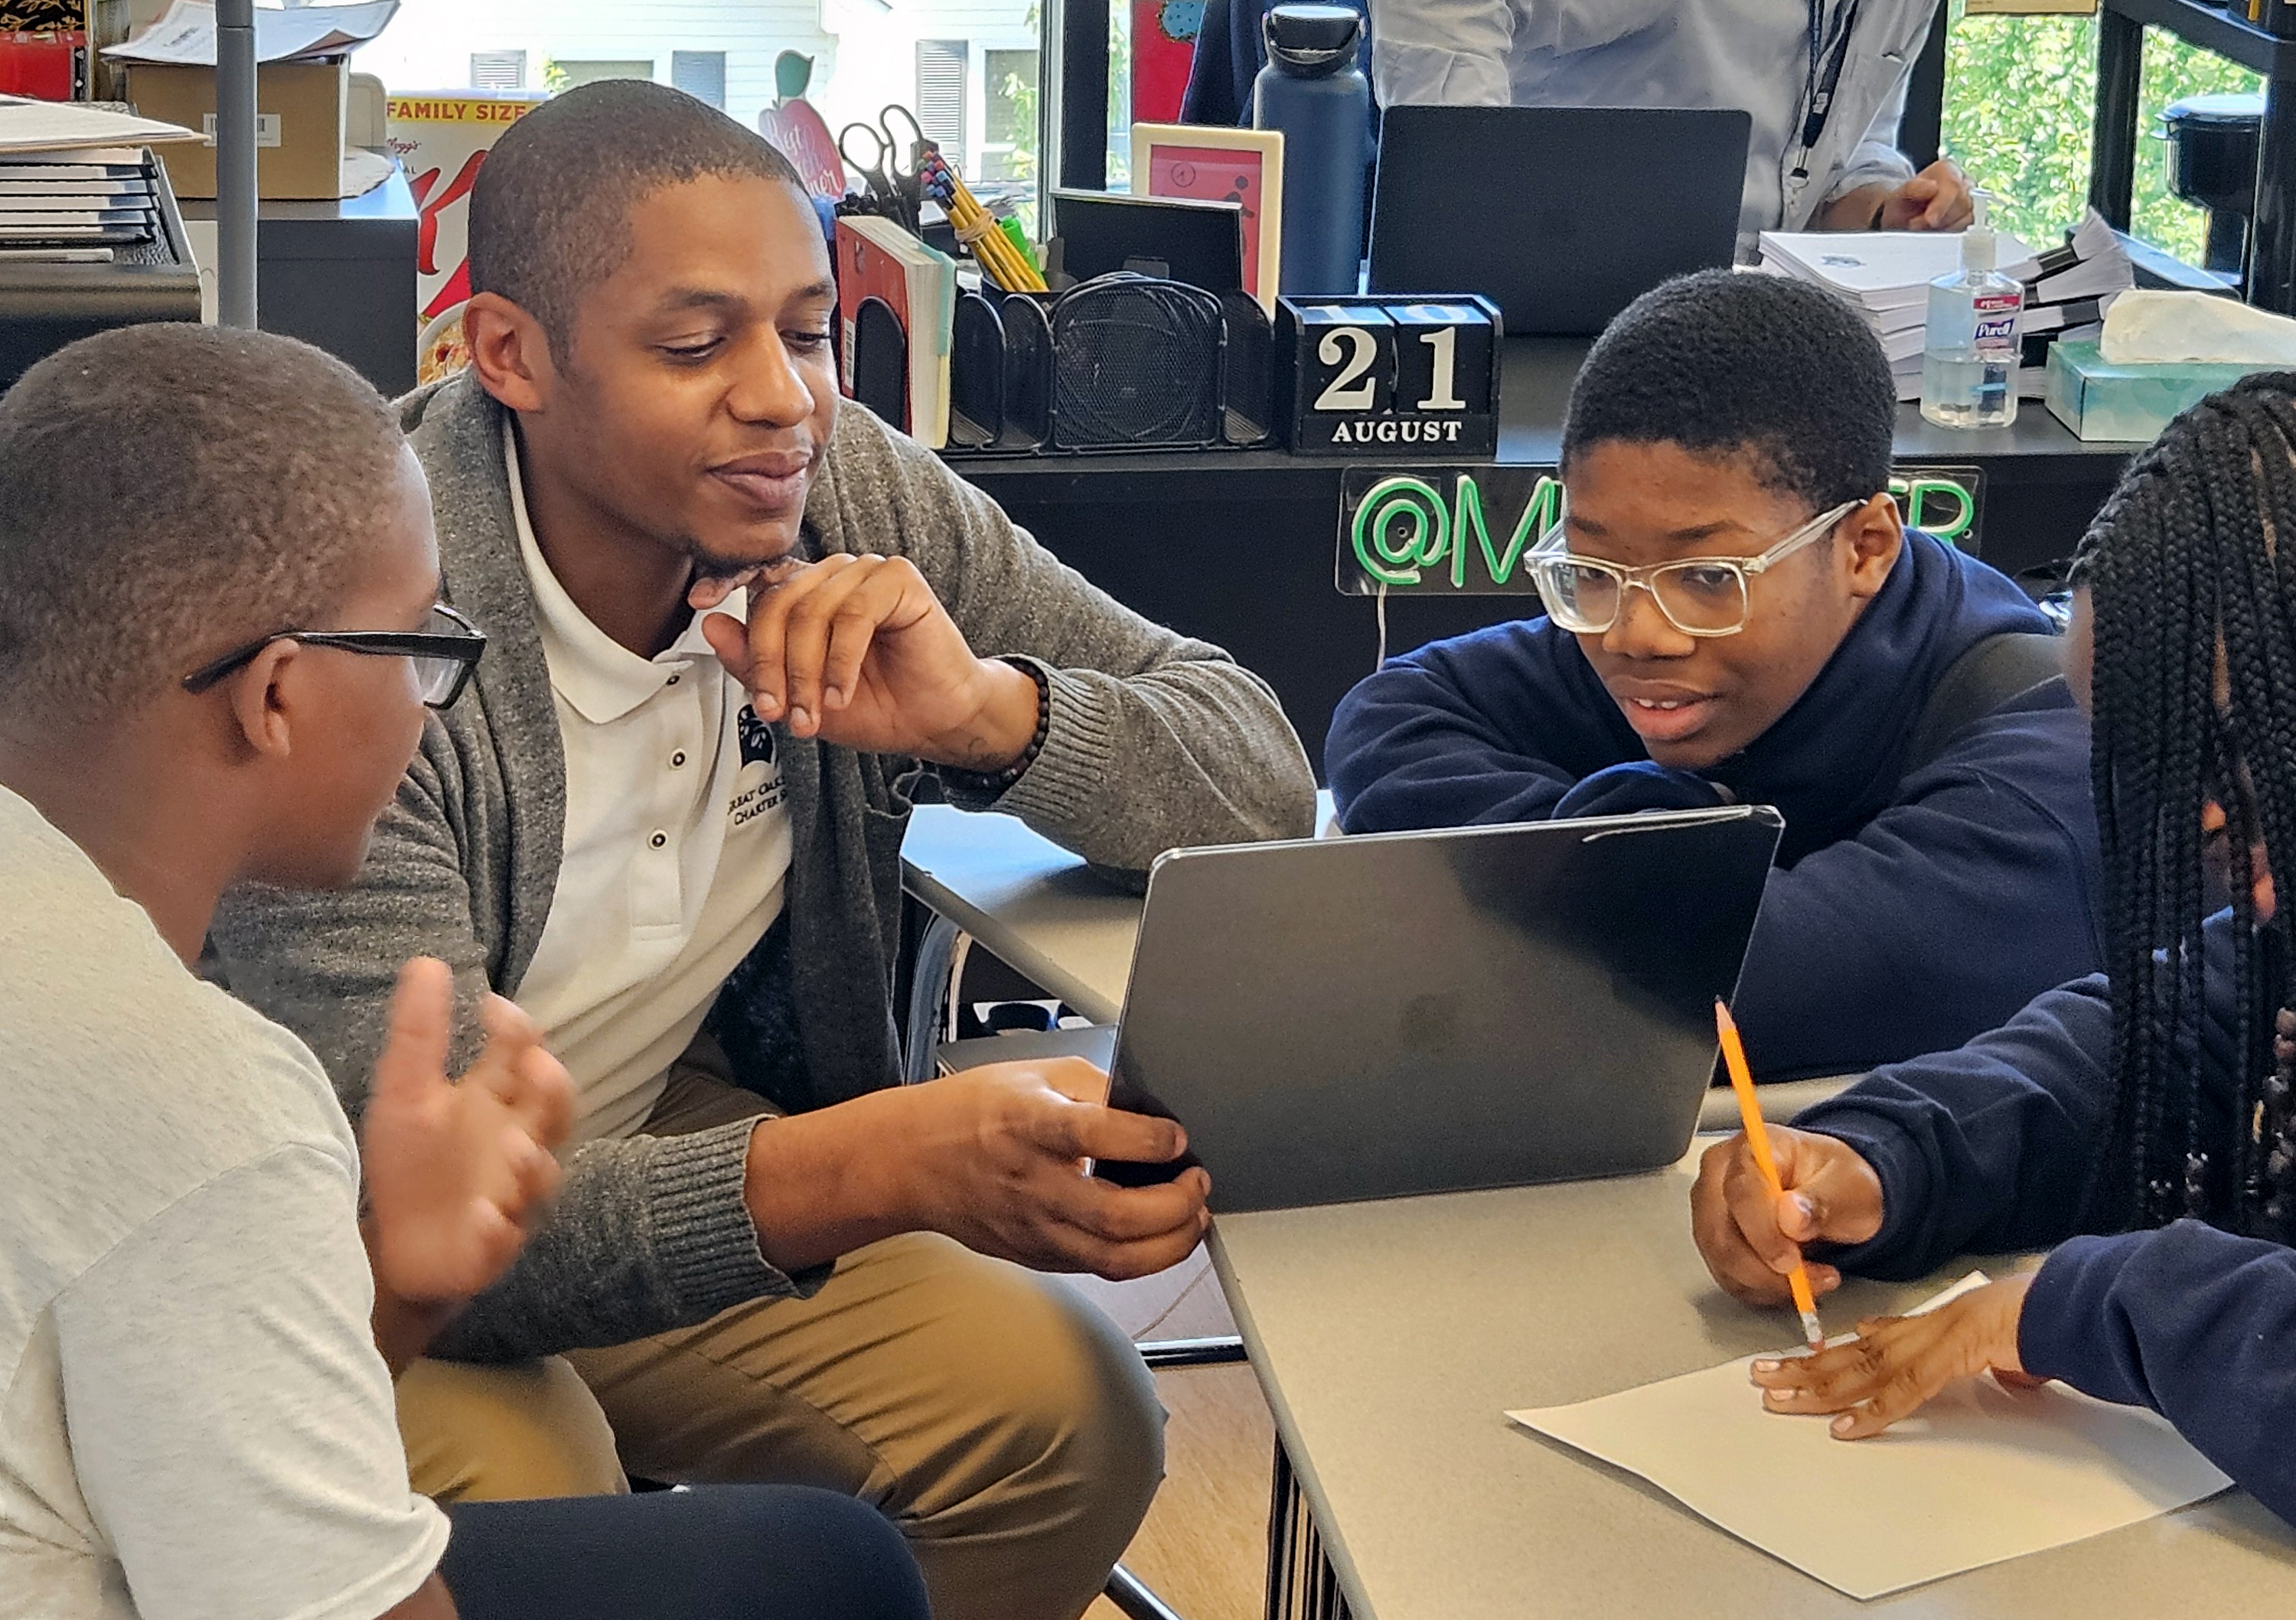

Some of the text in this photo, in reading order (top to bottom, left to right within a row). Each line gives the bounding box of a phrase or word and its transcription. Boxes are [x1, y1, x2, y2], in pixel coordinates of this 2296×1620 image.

[387, 101, 527, 121] FAMILY SIZE
[1978, 322, 2012, 337] Purell
[1313, 326, 1466, 410] 21
[1331, 421, 1463, 442] AUGUST
[727, 789, 755, 816] REAT
